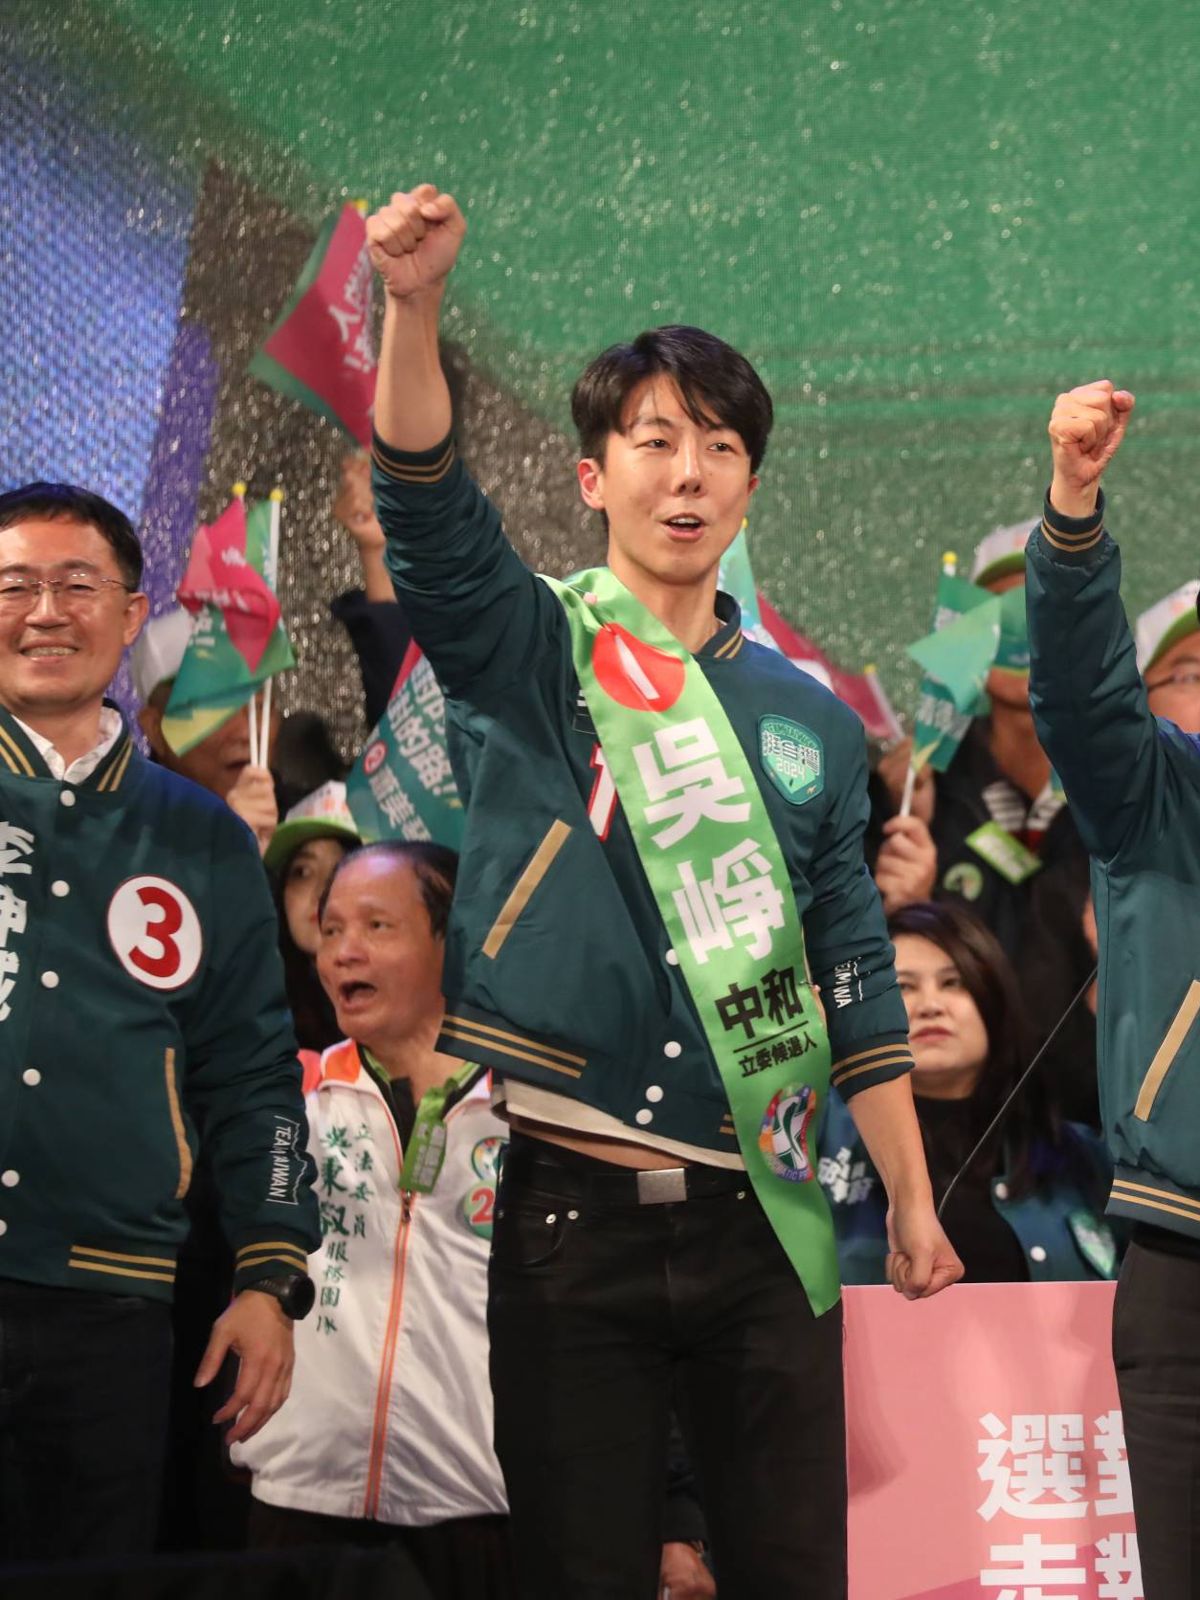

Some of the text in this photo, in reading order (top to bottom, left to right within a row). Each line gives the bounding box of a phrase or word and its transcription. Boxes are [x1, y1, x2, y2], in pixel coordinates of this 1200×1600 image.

[632, 717, 785, 965] 吳崢
[128, 886, 183, 978] 3
[714, 966, 805, 1040] 中和
[738, 1031, 818, 1078] 立委候選人
[350, 1123, 374, 1239] 立法委員
